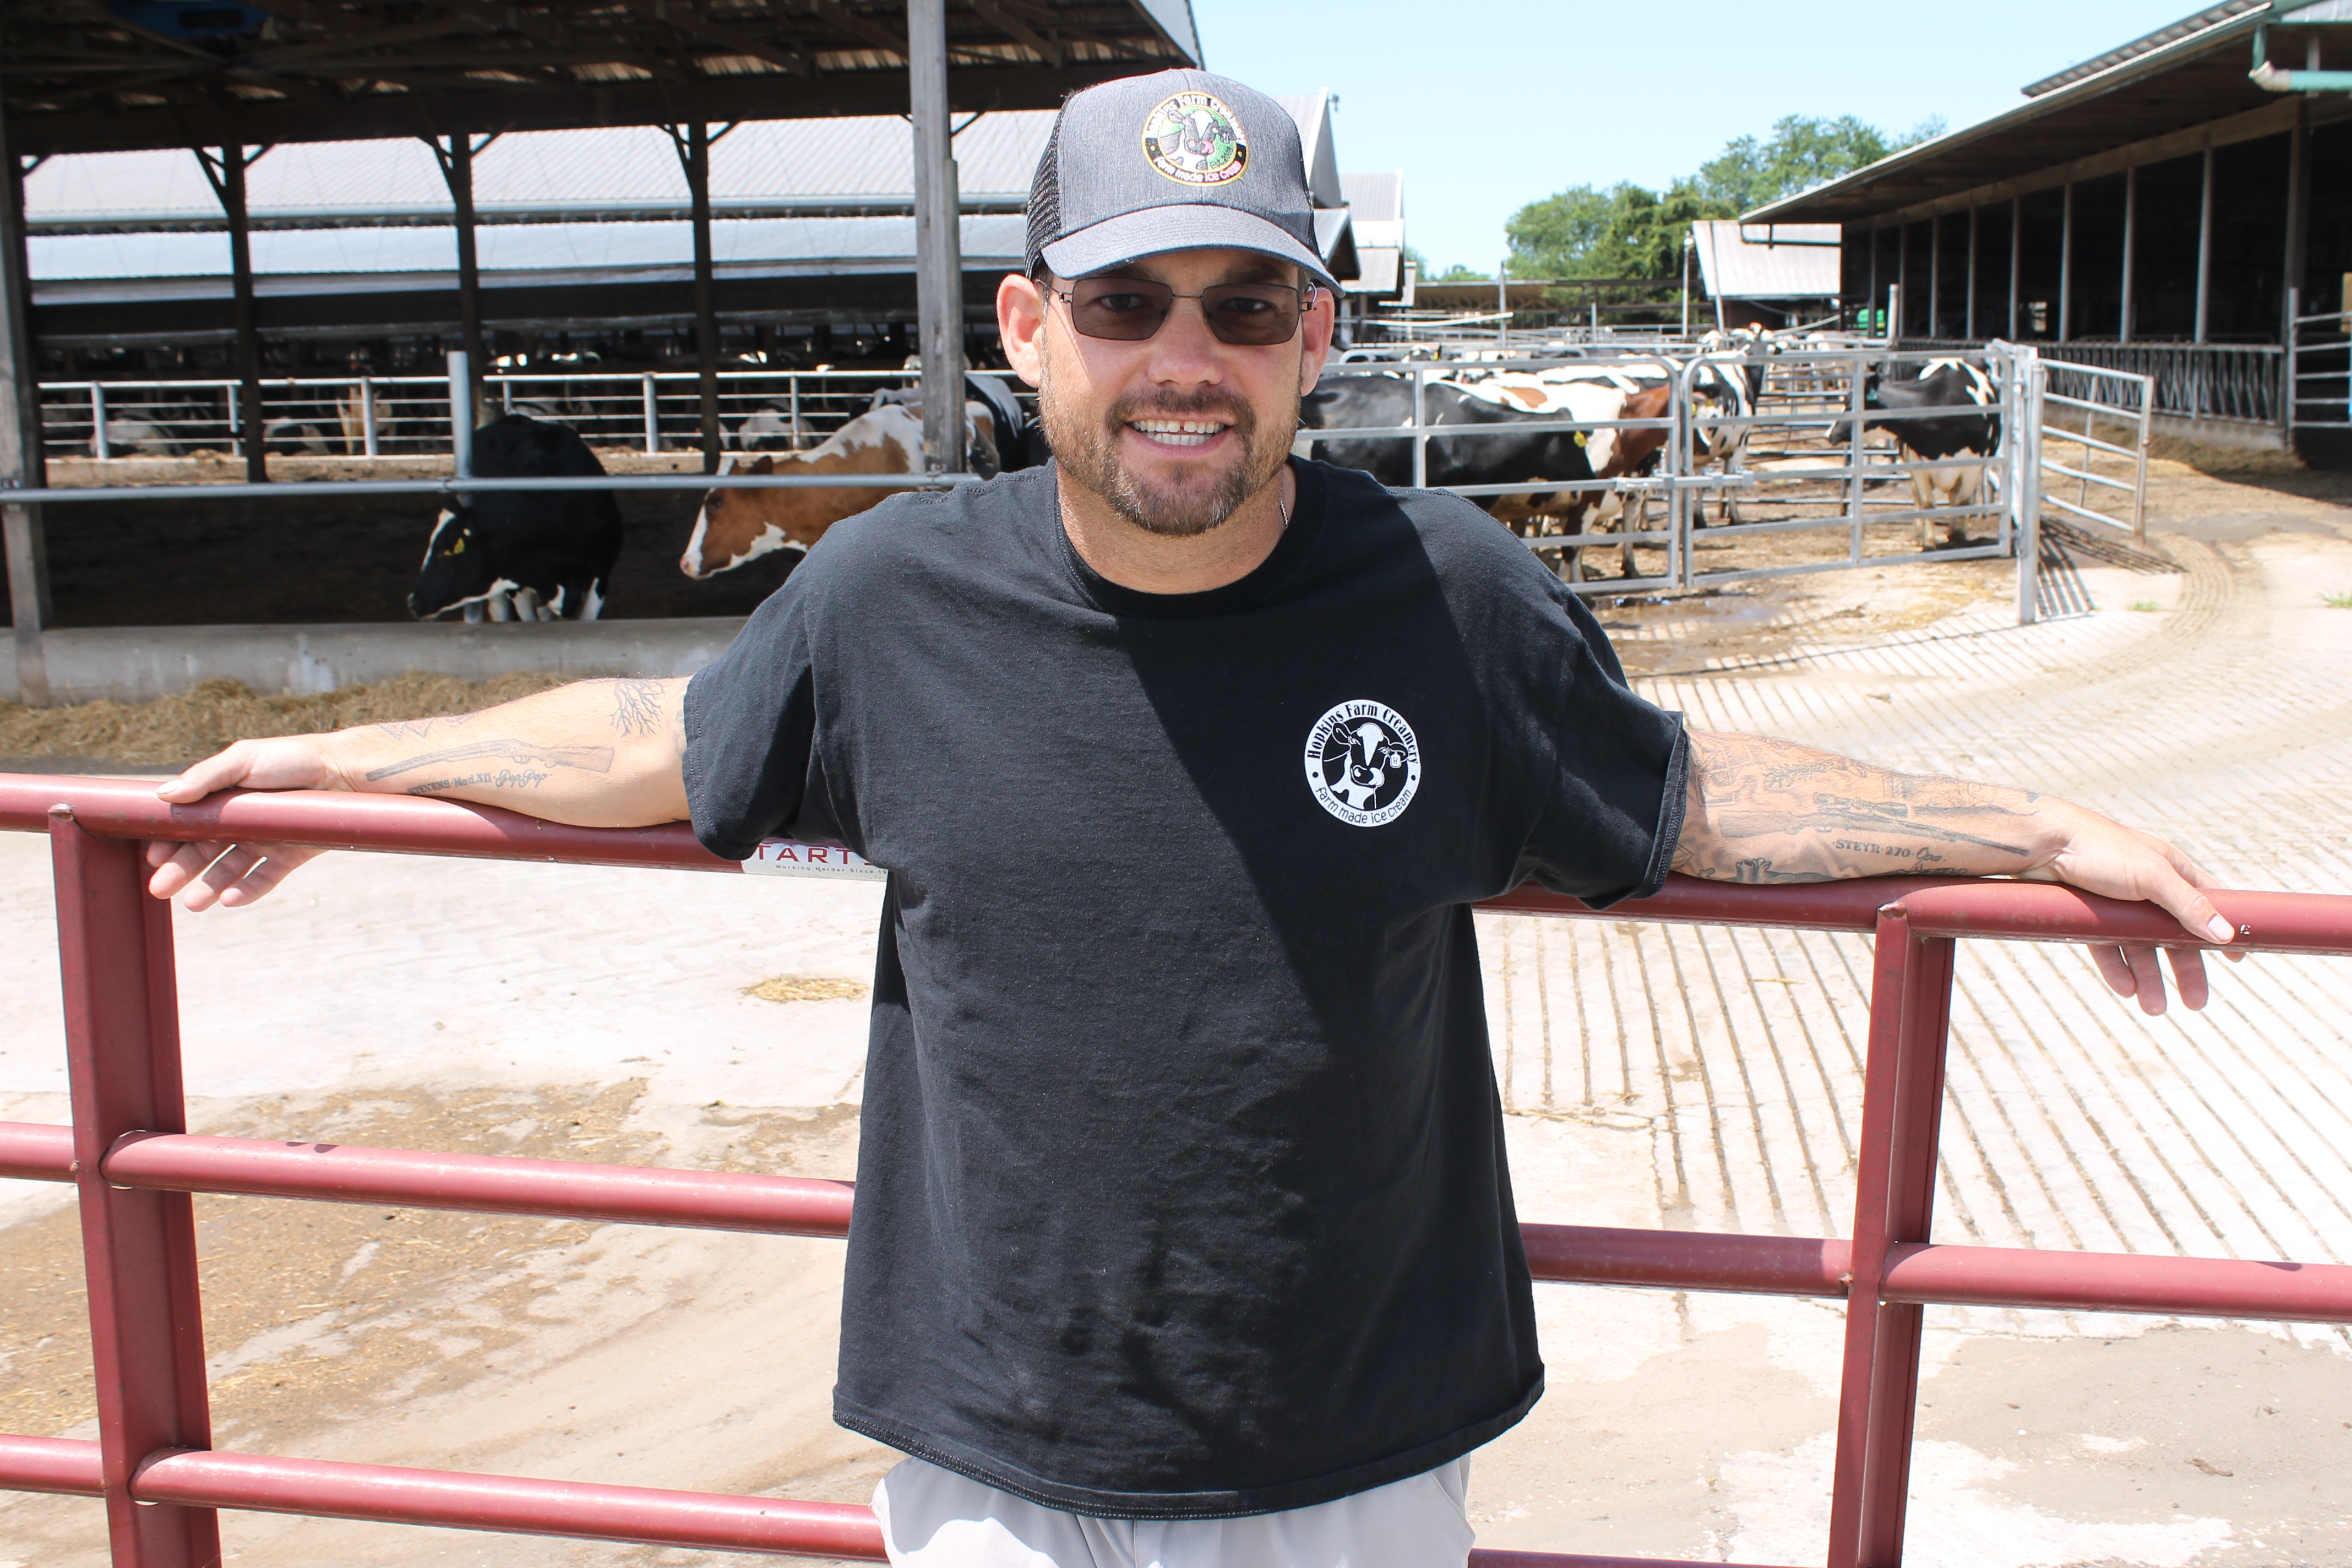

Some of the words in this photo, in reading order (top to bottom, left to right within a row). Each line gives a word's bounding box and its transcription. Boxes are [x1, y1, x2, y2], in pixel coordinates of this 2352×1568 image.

[1176, 94, 1208, 108] Farm
[1175, 169, 1204, 182] made
[1307, 711, 1344, 759] Hopkins
[1345, 704, 1378, 717] Farm
[1382, 709, 1418, 764] Creamery
[407, 780, 450, 794] STEVENS
[1338, 807, 1368, 824] made
[1371, 812, 1387, 824] ice
[757, 845, 872, 865] TART
[1836, 839, 1880, 853] STEYR
[1886, 846, 1910, 857] 270
